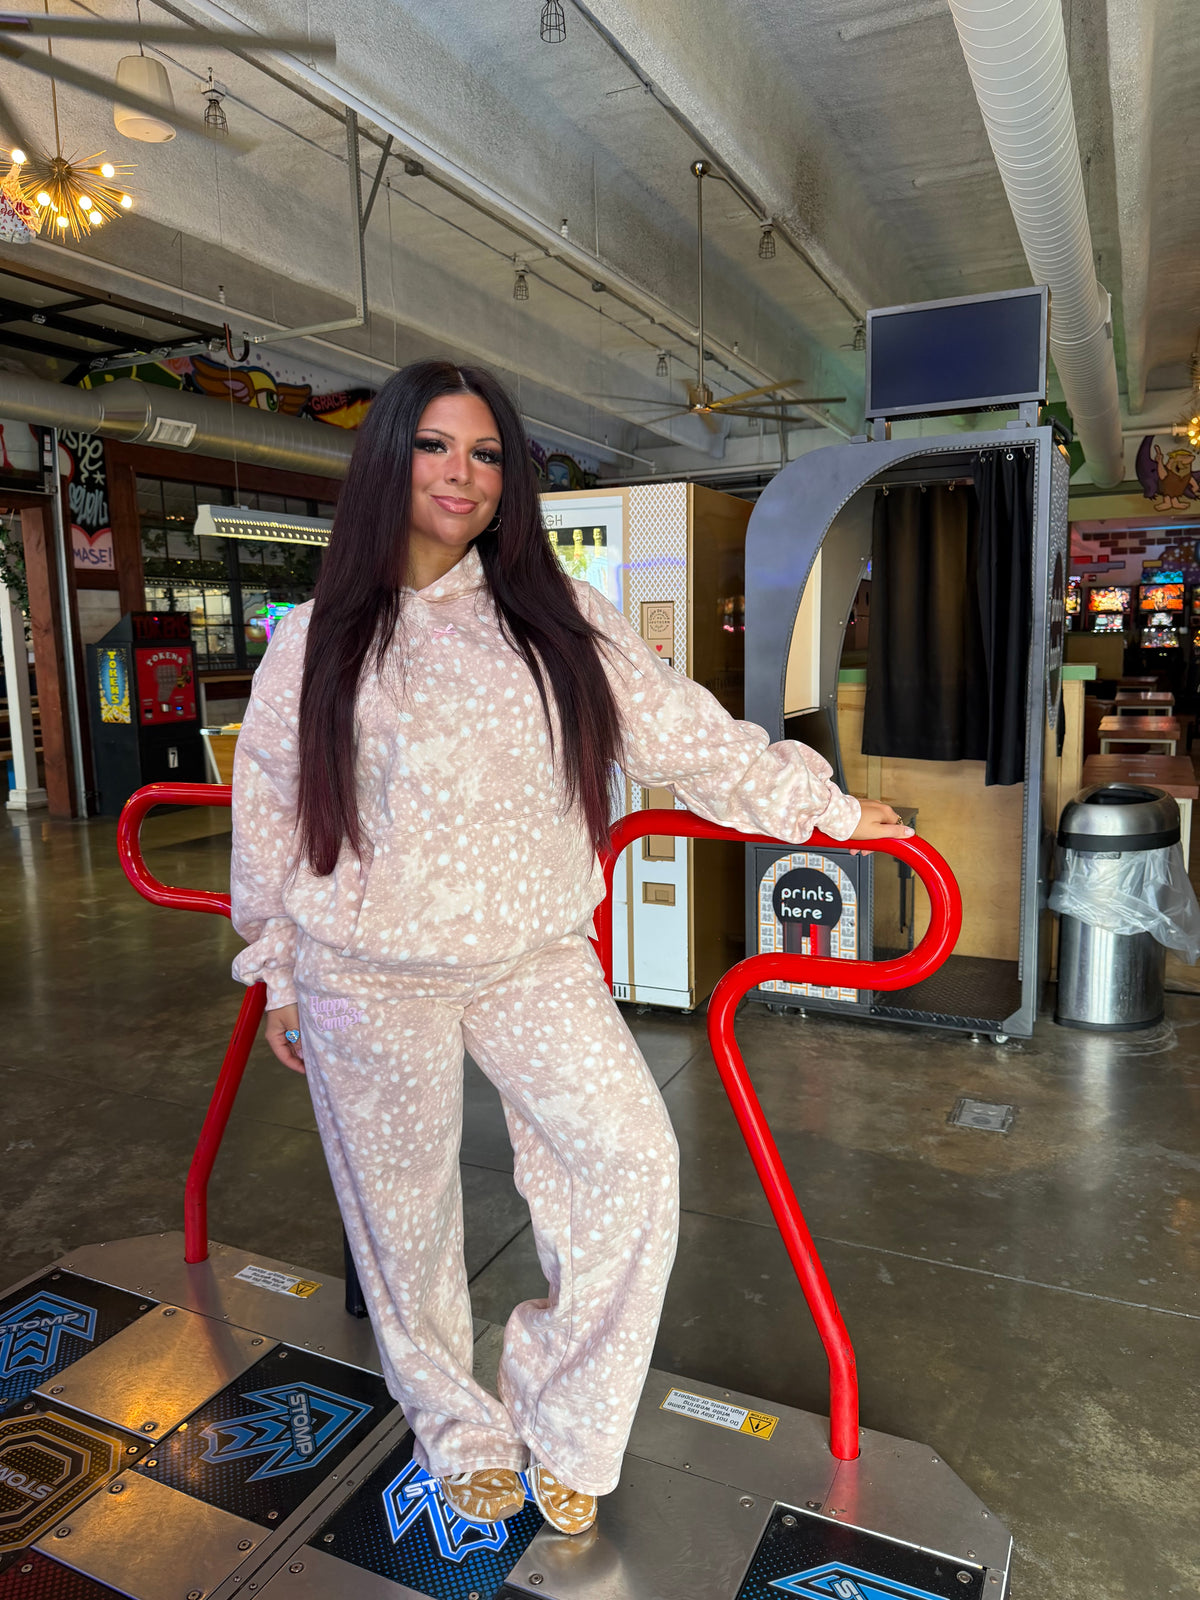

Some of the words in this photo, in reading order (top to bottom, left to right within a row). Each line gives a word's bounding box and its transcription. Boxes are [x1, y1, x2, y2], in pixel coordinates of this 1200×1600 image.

[311, 392, 347, 411] GRACE
[544, 514, 563, 527] GH
[146, 651, 184, 667] TOKENS
[107, 651, 120, 705] TOKENS
[781, 886, 834, 902] prints
[781, 902, 823, 920] here
[309, 995, 349, 1017] Happy
[667, 1400, 686, 1411] game
[682, 1400, 711, 1411] wearing
[687, 1407, 699, 1415] this
[290, 1393, 313, 1454] STOMP
[700, 1410, 716, 1420] play
[0, 1464, 54, 1499] STOM
[404, 1478, 437, 1499] ST
[834, 1579, 863, 1600] S
